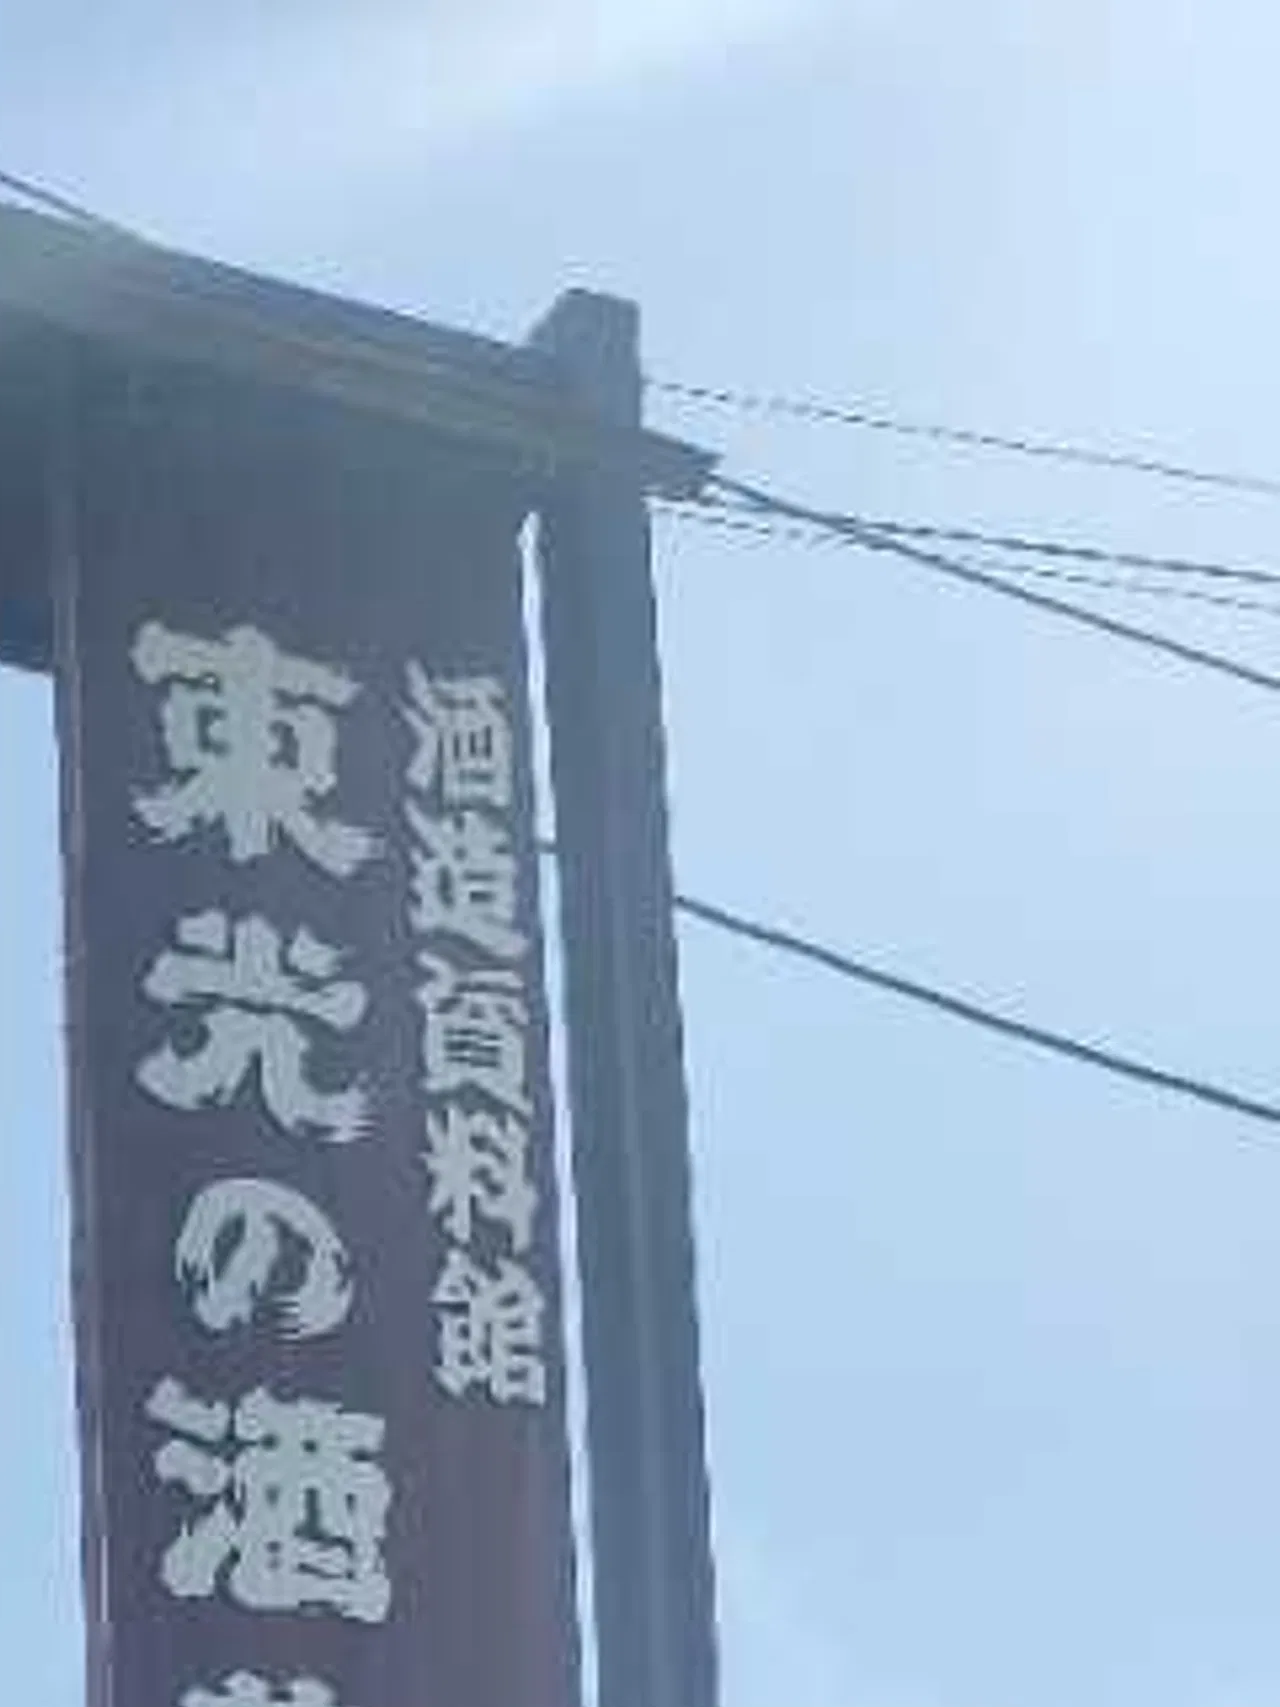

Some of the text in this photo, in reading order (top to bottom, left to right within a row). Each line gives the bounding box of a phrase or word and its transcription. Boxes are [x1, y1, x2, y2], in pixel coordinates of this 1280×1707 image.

[403, 658, 547, 1406] 酒造資料館
